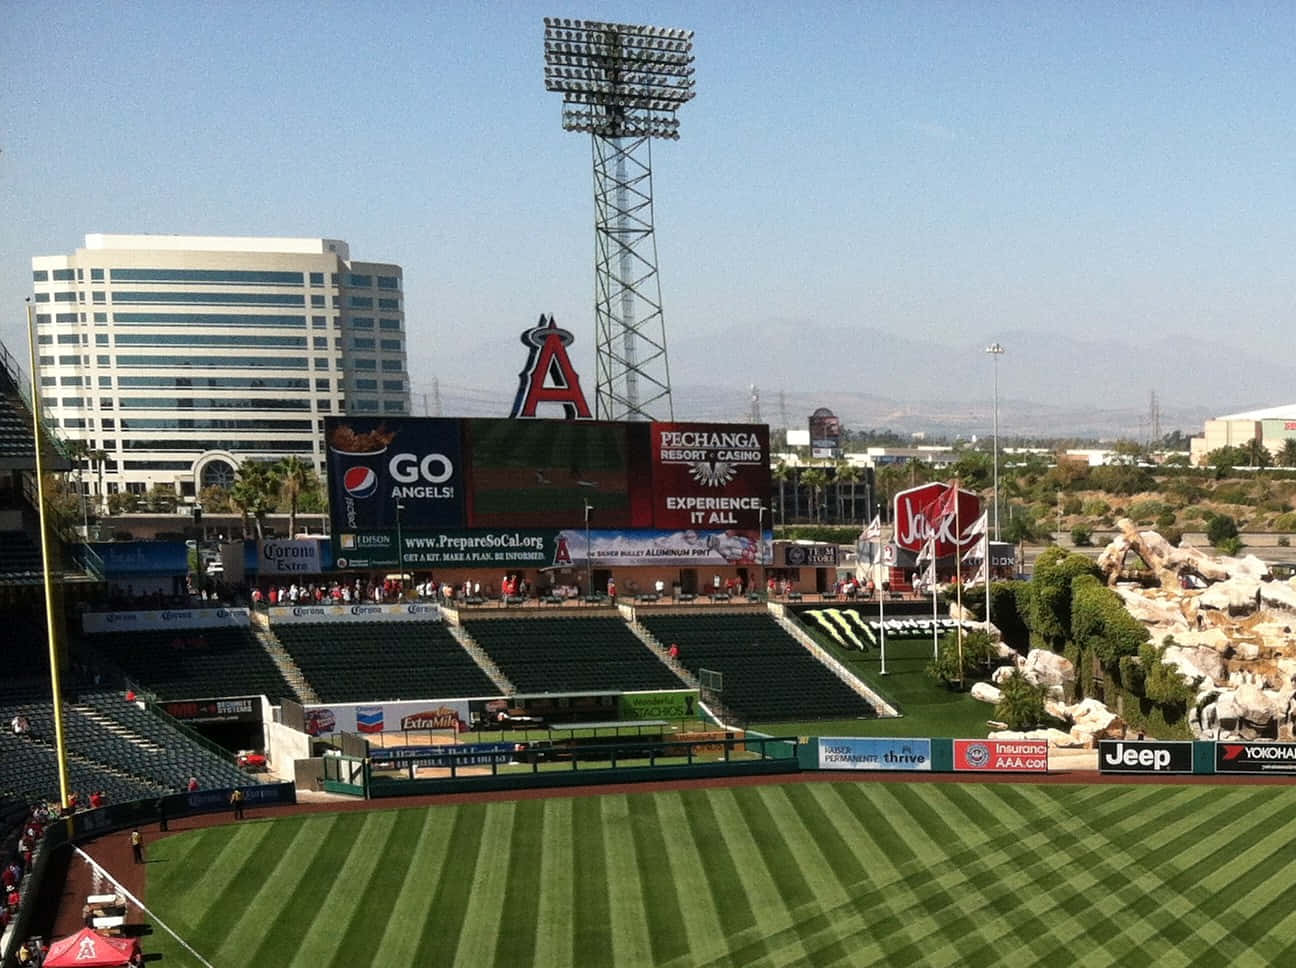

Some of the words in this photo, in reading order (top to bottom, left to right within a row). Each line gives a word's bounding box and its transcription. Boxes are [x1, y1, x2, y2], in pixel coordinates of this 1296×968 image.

[660, 432, 760, 448] PECHANGA
[661, 450, 707, 460] RESORT
[717, 451, 761, 461] CASINO
[389, 453, 453, 483] GO
[392, 486, 454, 498] ANGELS!
[667, 497, 760, 509] EXPERIENCE
[691, 512, 704, 524] IT
[709, 512, 738, 524] ALL
[405, 533, 543, 550] www.PrepareSoCal.org
[264, 543, 314, 560] Corona
[443, 553, 464, 561] MAKE
[646, 549, 690, 557] ALUMINUM
[692, 549, 710, 557] PINT
[277, 560, 308, 572] Extra
[992, 556, 1015, 567] box
[293, 607, 325, 617] Corona
[351, 605, 382, 616] Corona
[407, 604, 438, 614] Corona
[995, 743, 1048, 754] Insuranc
[883, 751, 925, 764] thrive
[1105, 743, 1171, 770] Jeep
